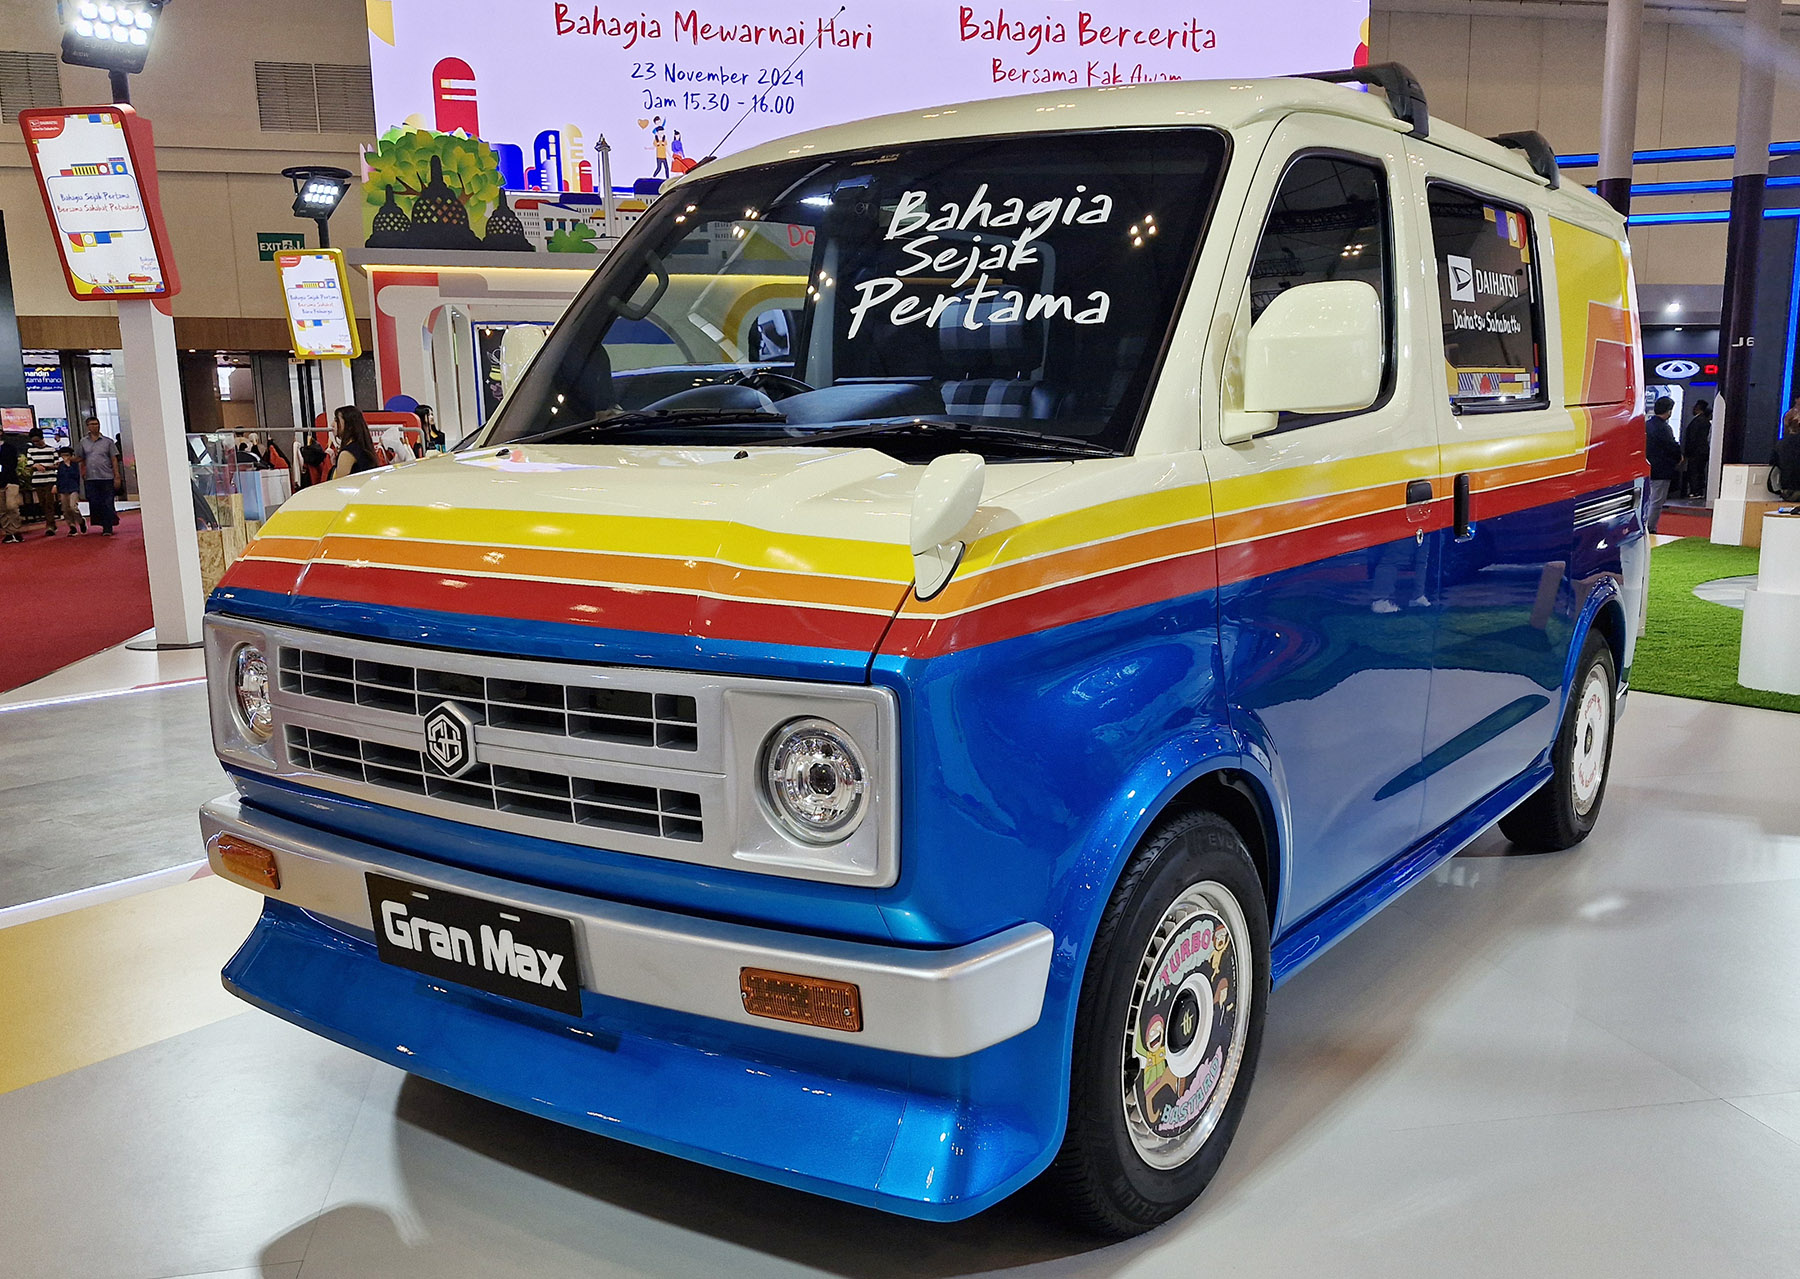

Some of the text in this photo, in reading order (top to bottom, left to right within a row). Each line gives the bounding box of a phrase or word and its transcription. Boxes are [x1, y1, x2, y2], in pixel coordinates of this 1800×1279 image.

[554, 2, 873, 50] Bahagia Mewarnai Hari
[959, 5, 1217, 55] Bahagia Bercerita
[630, 62, 805, 88] 23 November 2024
[992, 57, 1079, 84] Bersama
[1087, 60, 1123, 88] Kak
[641, 88, 678, 110] Jam
[683, 92, 731, 112] 15.30
[751, 93, 796, 115] 16.00
[885, 183, 1113, 241] Bahagia
[259, 242, 282, 251] EXIT
[896, 226, 1039, 288] Sejak
[847, 272, 1111, 340] Pertama
[1475, 268, 1520, 298] DAIHATSU
[1452, 307, 1486, 331] Daihatsu
[380, 899, 568, 992] Gran Max
[1159, 928, 1212, 987] TURBO
[1160, 1057, 1220, 1125] BASTARD
